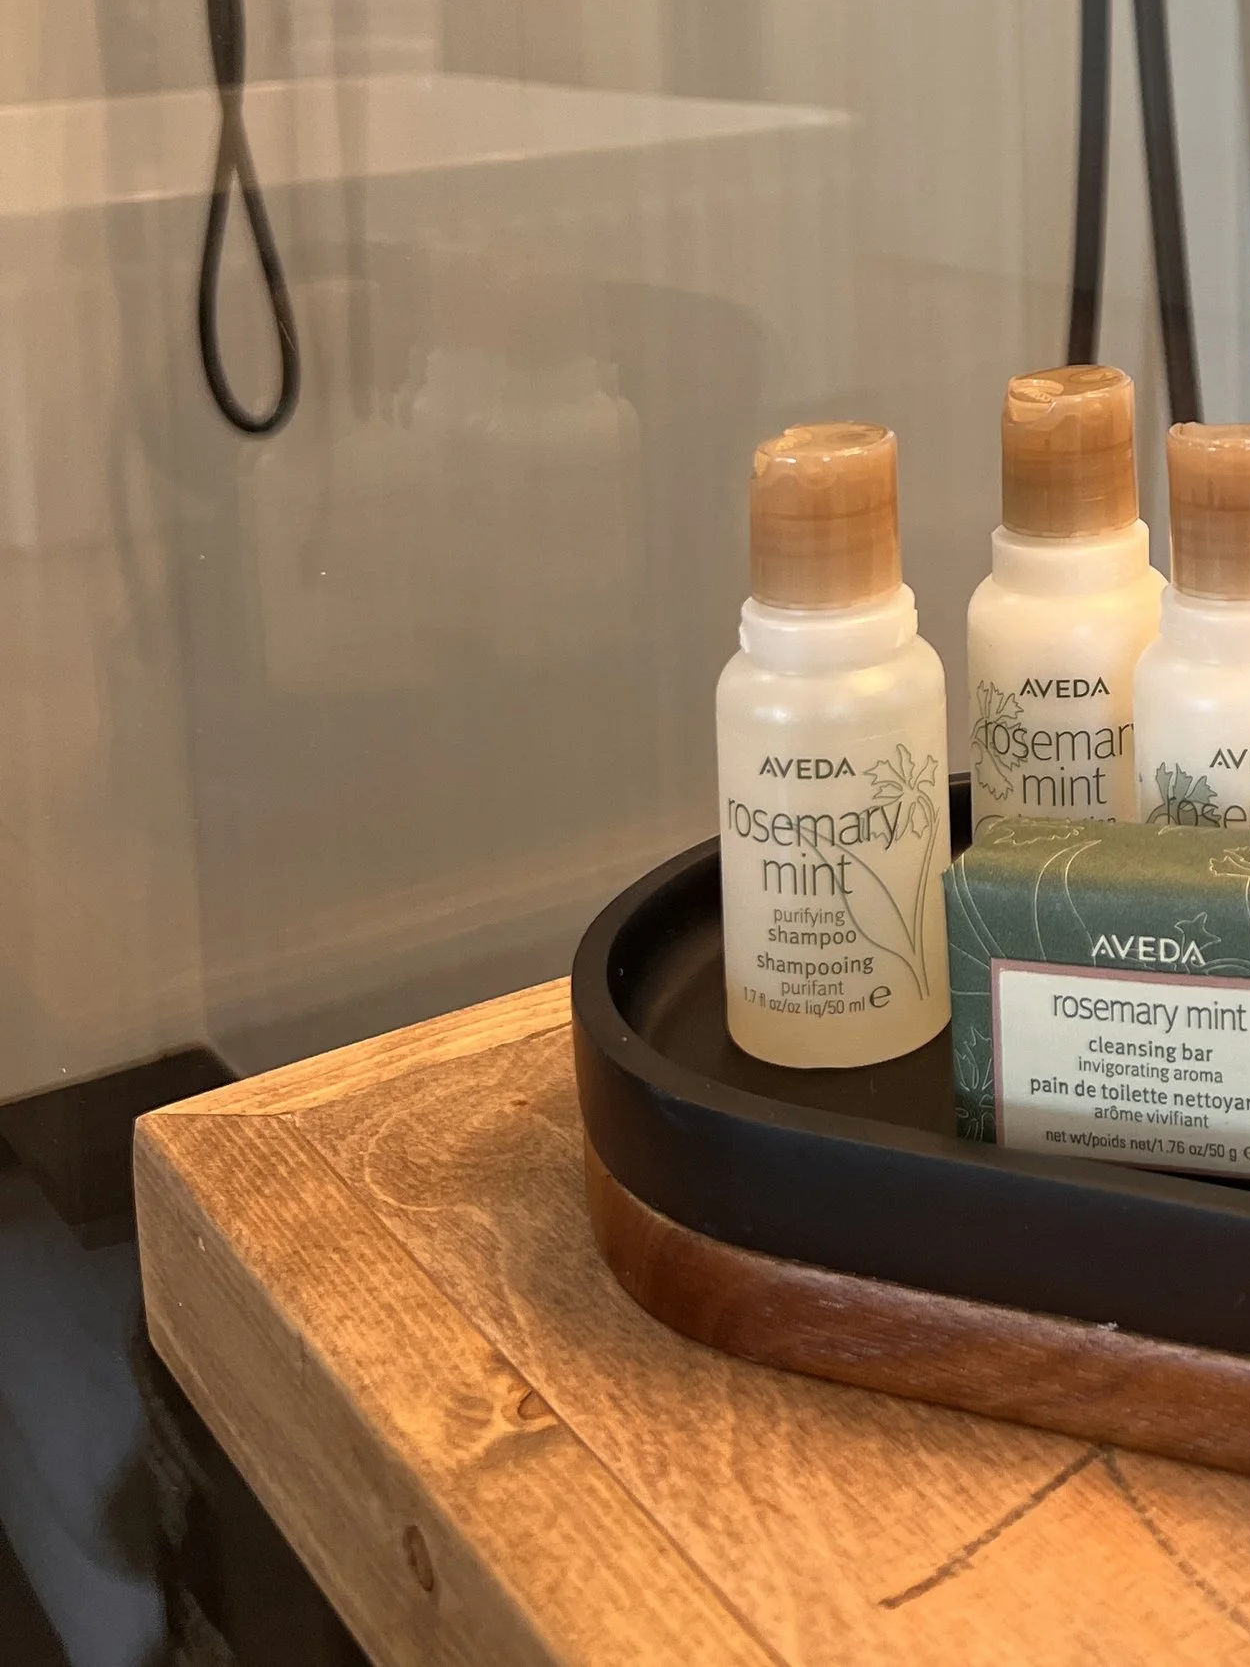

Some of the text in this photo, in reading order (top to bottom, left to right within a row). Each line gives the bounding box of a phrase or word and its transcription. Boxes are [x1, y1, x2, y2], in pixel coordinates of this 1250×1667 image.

[1019, 676, 1110, 698] AVEDA
[984, 719, 1134, 761] rosemar
[759, 756, 856, 779] AVEDA
[1021, 766, 1108, 807] mint
[728, 797, 903, 850] rosemary
[763, 853, 854, 897] mint
[774, 908, 846, 927] purifying
[768, 925, 857, 950] shampoo
[1091, 934, 1206, 965] AVEDA
[757, 952, 875, 979] shampooing
[781, 980, 845, 996] purifant
[769, 998, 801, 1014] oz/oz
[805, 999, 845, 1018] liq/50
[849, 996, 866, 1013] ml
[1053, 993, 1248, 1034] rosemary mint
[1088, 1036, 1214, 1063] cleansing bar
[1078, 1056, 1224, 1084] invigorating aroma
[1030, 1077, 1069, 1095] pain
[1074, 1080, 1097, 1098] de
[1101, 1084, 1168, 1105] toilette
[1094, 1105, 1209, 1129] arôme vivifiant
[1045, 1129, 1067, 1144] net
[1069, 1131, 1127, 1150] wt/poids
[1130, 1137, 1185, 1155] net/1.76
[1189, 1142, 1225, 1159] oz/50
[1229, 1147, 1237, 1162] g
